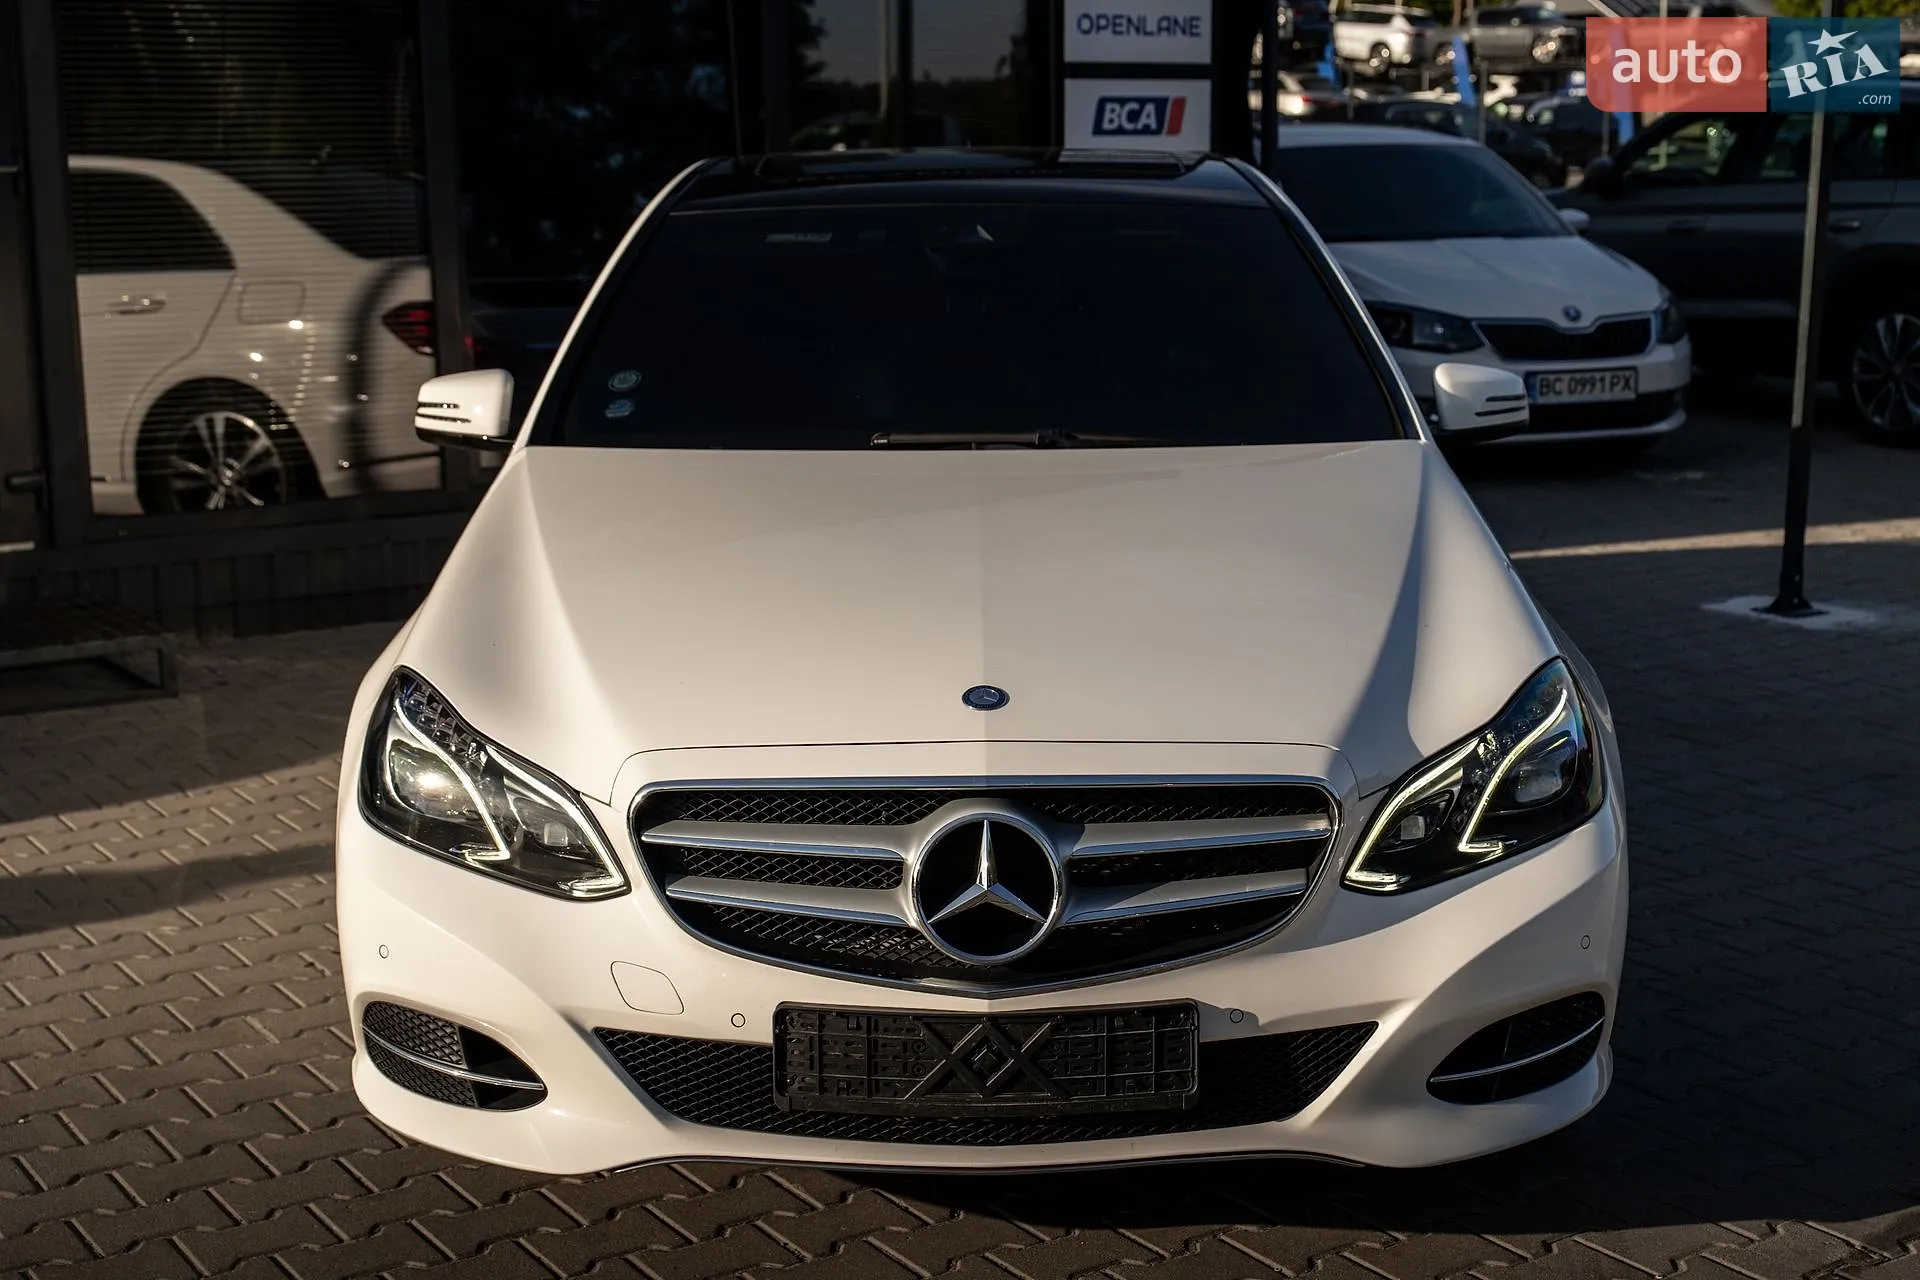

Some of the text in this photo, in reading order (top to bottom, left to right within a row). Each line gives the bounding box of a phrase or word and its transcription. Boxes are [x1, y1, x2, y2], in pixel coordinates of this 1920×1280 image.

[1077, 13, 1202, 37] OPENLANE
[1102, 101, 1158, 131] BCA
[1539, 375, 1564, 396] BC
[1609, 372, 1634, 393] PX
